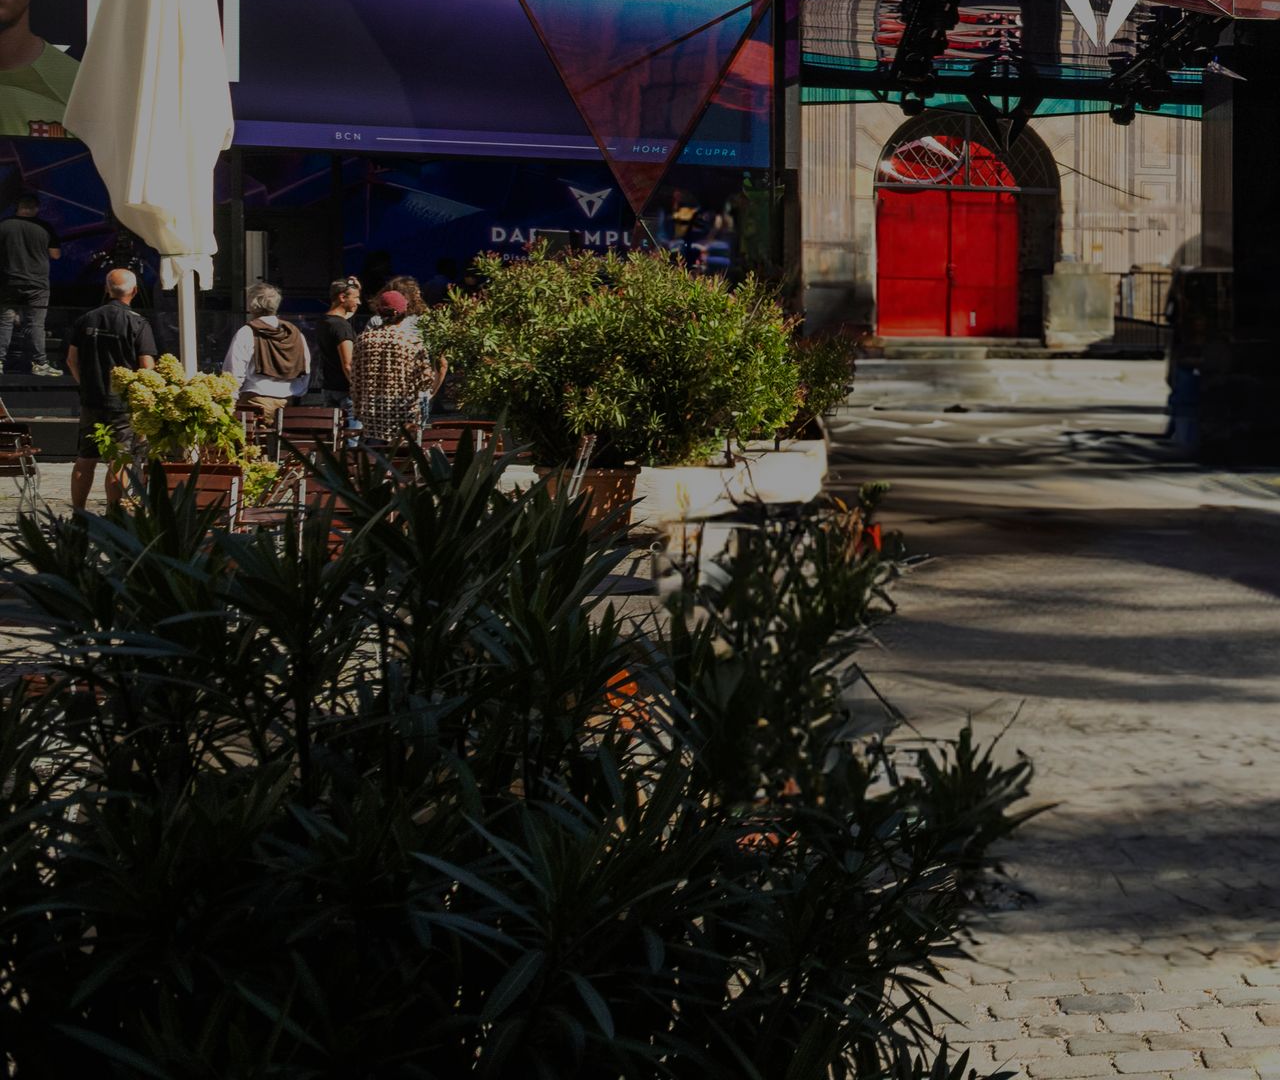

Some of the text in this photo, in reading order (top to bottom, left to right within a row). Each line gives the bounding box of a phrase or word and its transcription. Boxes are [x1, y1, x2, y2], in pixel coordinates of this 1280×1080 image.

[335, 131, 361, 140] BCN
[632, 145, 669, 154] HOME
[695, 147, 737, 157] CUPRA
